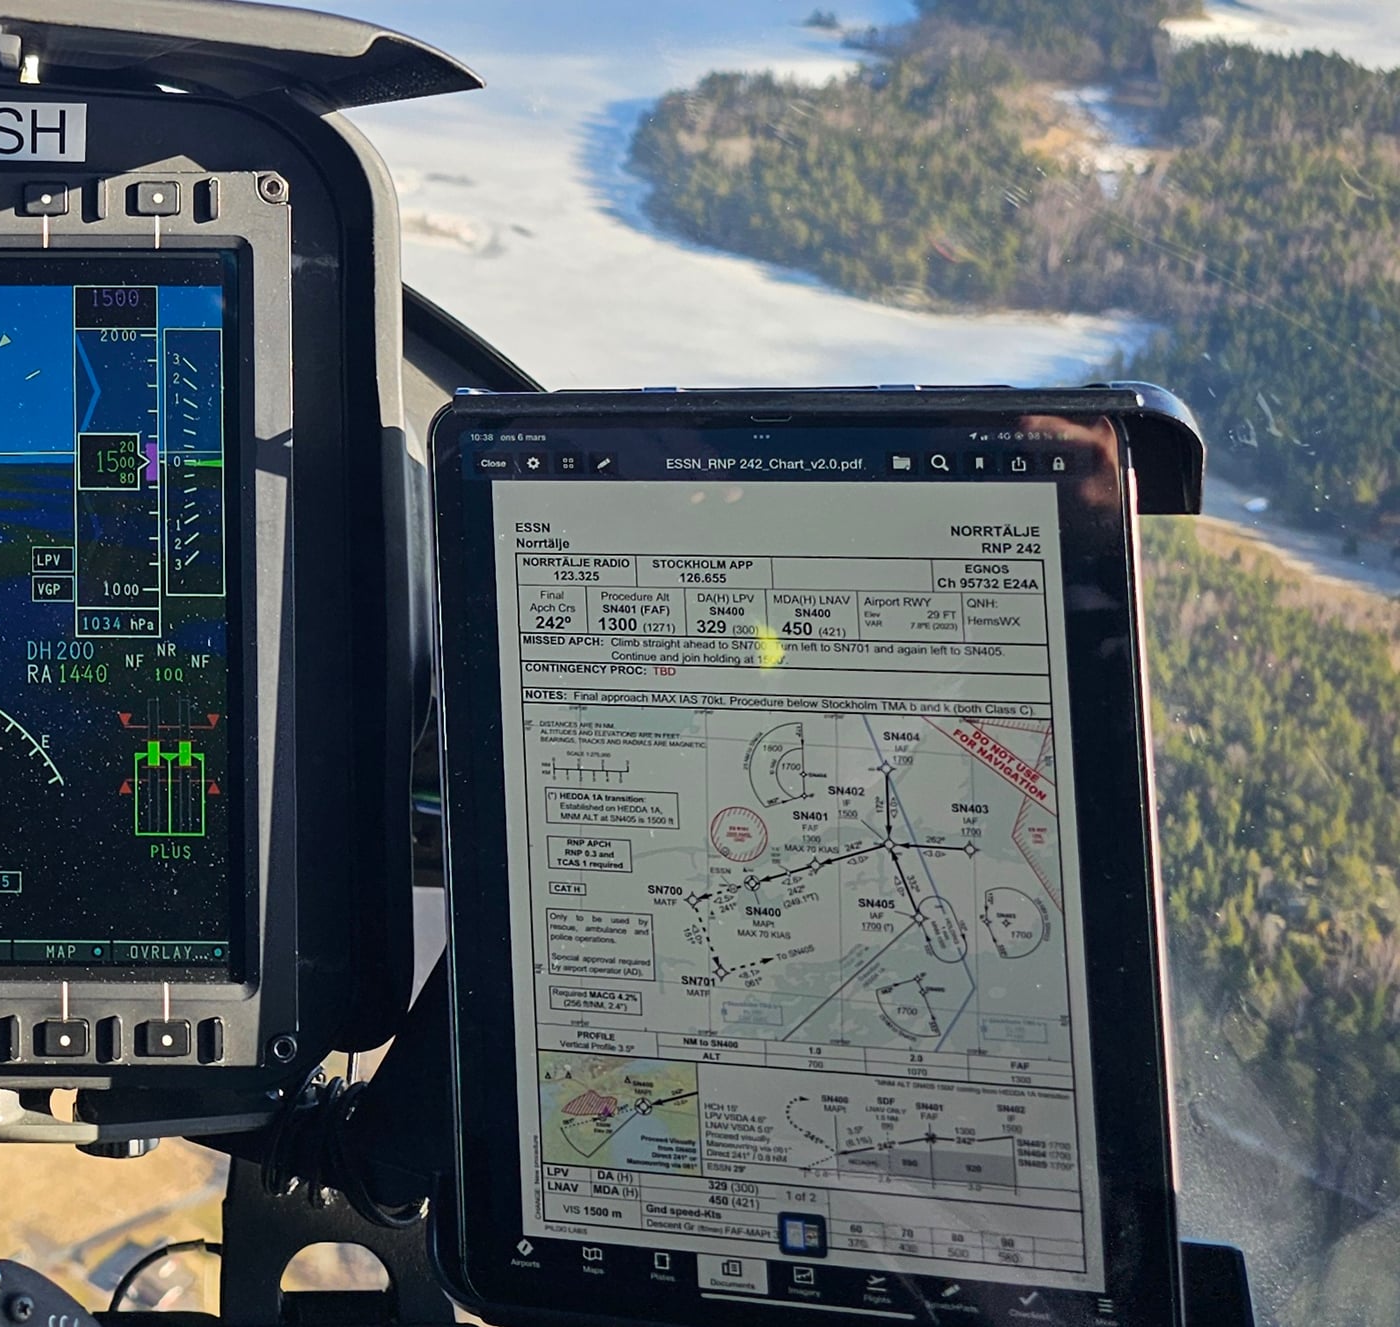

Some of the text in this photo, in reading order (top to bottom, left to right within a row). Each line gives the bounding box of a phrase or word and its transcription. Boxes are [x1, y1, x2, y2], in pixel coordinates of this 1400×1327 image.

[94, 290, 139, 307] 1500
[470, 433, 493, 441] 10:38
[481, 459, 506, 467] Close
[666, 458, 862, 470] ESSN_RNP 242_Chart_v2.0.pdf
[515, 522, 551, 532] ESSN
[951, 524, 1040, 537] NORRTÄLJE
[516, 538, 569, 549] Norrtälje
[982, 543, 1041, 554] RNP 242
[37, 555, 60, 566] LPV
[523, 556, 629, 568] NORRTÄLJE RADIO
[652, 560, 753, 569] STOCKHOLM APP
[965, 564, 1009, 574] EGNOS
[554, 571, 599, 581] 123.325
[680, 574, 727, 583] 126.655
[959, 578, 1038, 589] 95732 E24A
[540, 591, 564, 600] Final
[601, 592, 654, 602] Procedure
[697, 594, 754, 604] DA(H) LPV
[773, 594, 850, 606] MDA(H) LNAV
[530, 604, 555, 613] Apch
[864, 598, 931, 608] Airport RWY
[603, 605, 670, 616] SN401 (FAF)
[709, 607, 744, 616] SN400
[795, 609, 831, 618] SN400
[83, 617, 154, 630] 1034 hPa
[598, 618, 675, 633] 1300 (1271)
[697, 620, 726, 633] 329
[968, 617, 1020, 627] HemsWX
[782, 622, 812, 636] 450
[523, 635, 712, 650] MISSED APCH: Climb straight ahead
[27, 641, 94, 660] DH 200
[60, 664, 107, 683] 1440
[525, 664, 676, 676] CONTINGENCY PROC: TBD
[525, 690, 648, 704] NOTES: Final approach
[883, 731, 920, 741] SN404
[793, 811, 828, 821] SN401
[151, 845, 191, 859] PLUS
[648, 885, 683, 896] SN700
[858, 899, 895, 909] SN405
[746, 906, 781, 917] SN400
[46, 946, 76, 958] MAP
[681, 976, 715, 987] SN701
[547, 1168, 569, 1178] LPV
[548, 1182, 578, 1192] LNAV
[584, 1206, 608, 1218] 1500
[511, 1258, 540, 1269] Airports
[710, 1278, 756, 1290] Documents
